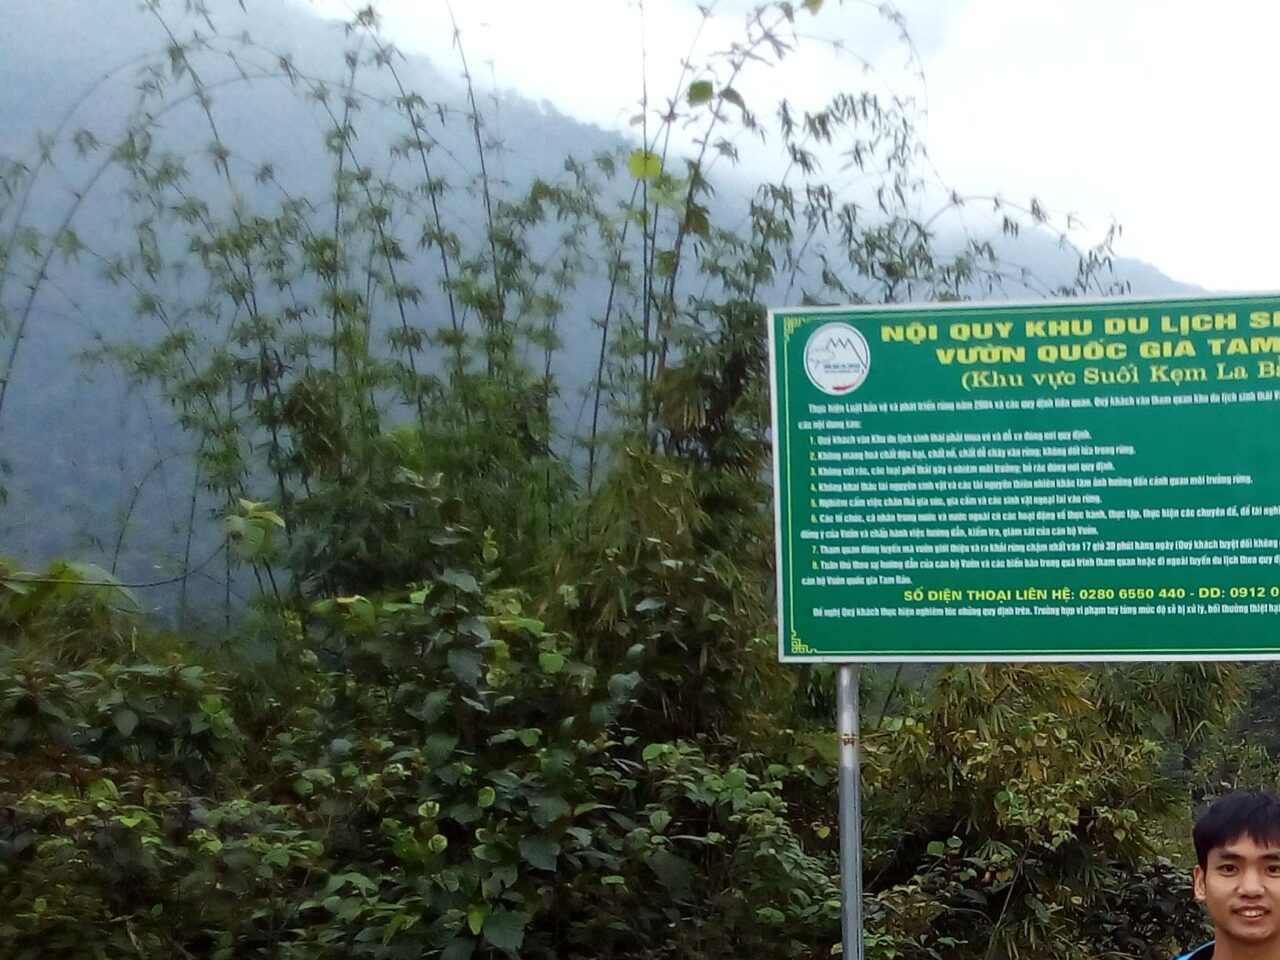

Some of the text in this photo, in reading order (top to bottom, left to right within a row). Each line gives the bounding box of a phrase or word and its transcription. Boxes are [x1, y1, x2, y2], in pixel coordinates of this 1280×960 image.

[880, 321, 937, 344] NỘI
[949, 321, 1013, 341] QUY
[1025, 318, 1092, 337] KHU
[1104, 316, 1148, 334] DU
[1161, 312, 1236, 335] LỊCH
[1037, 339, 1126, 363] QUỐC
[1139, 339, 1195, 358] GIA
[1207, 335, 1280, 355] TAM
[1083, 363, 1138, 384] Suối
[1216, 362, 1248, 379] La
[966, 589, 1011, 603] THOẠI
[1015, 587, 1047, 600] LIÊN
[1079, 588, 1114, 599] 0280
[1118, 588, 1154, 599] 6550
[1158, 588, 1185, 598] 440
[1229, 587, 1265, 597] 0912
